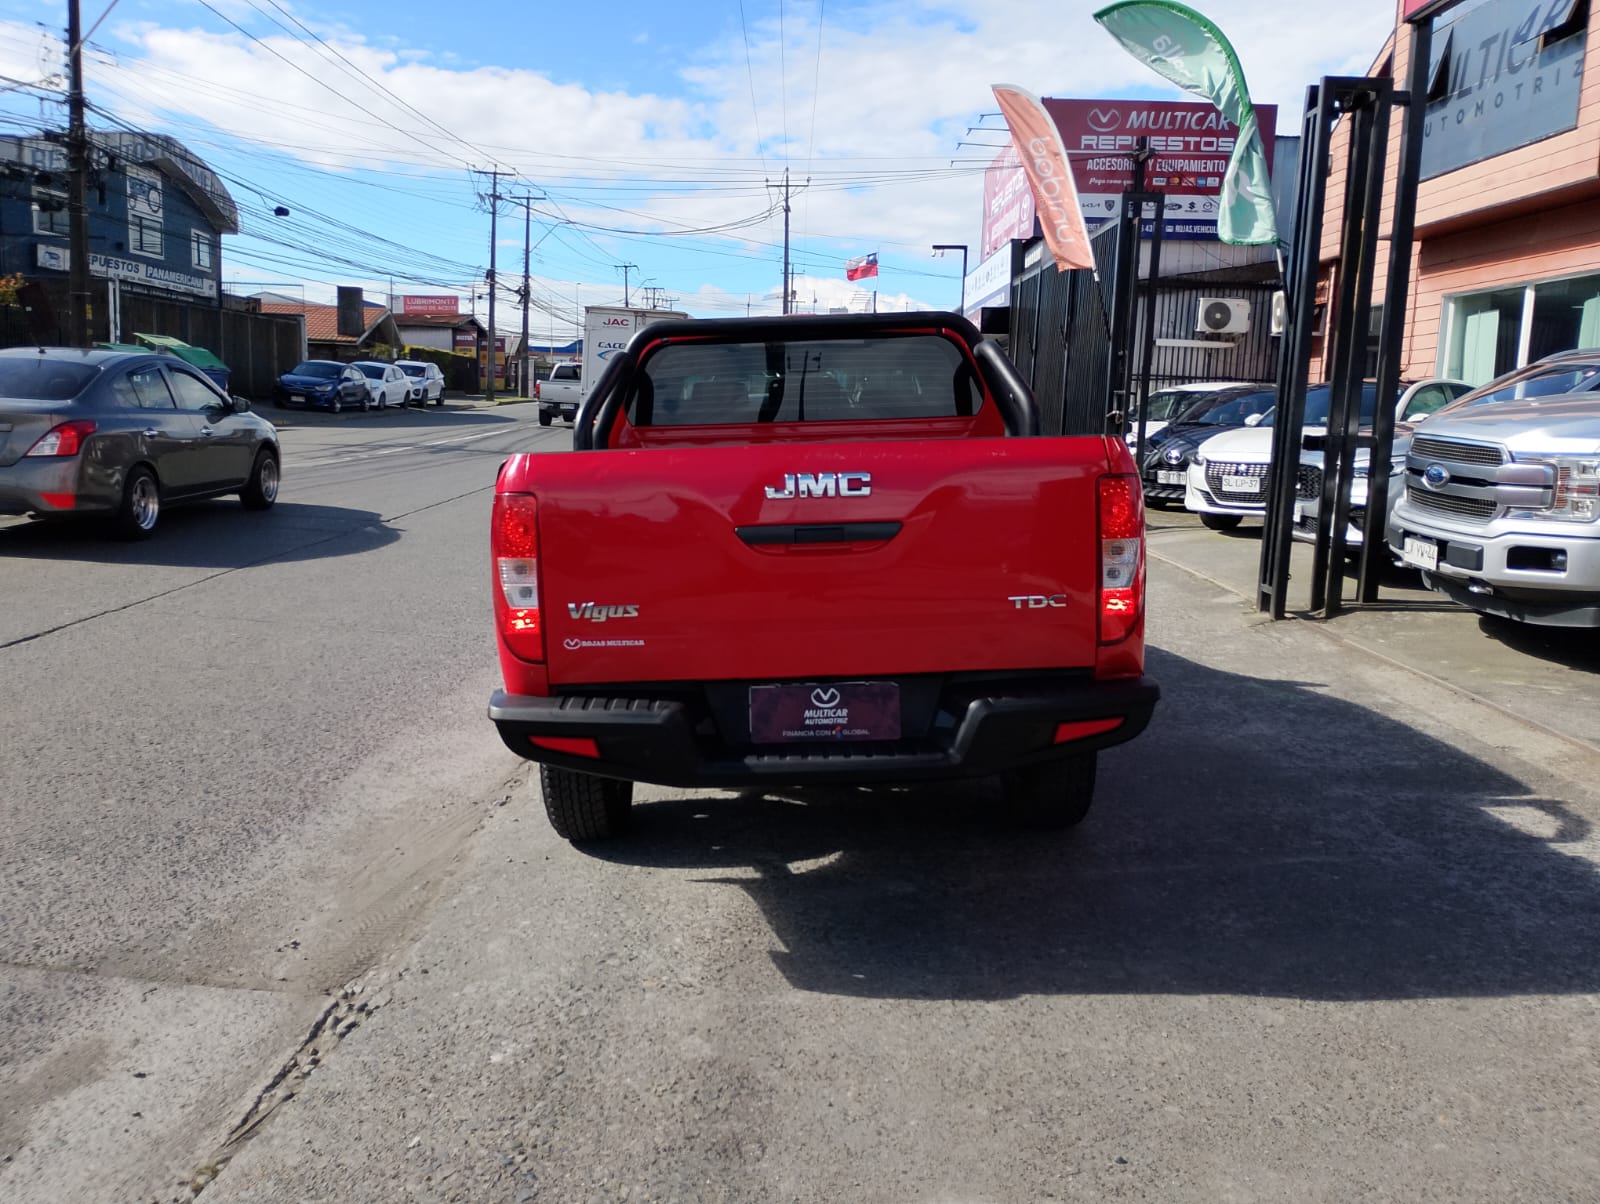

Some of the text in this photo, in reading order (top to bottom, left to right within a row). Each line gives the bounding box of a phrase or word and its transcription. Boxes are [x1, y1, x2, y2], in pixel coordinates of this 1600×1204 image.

[1425, 57, 1585, 138] UTOMOTRIZ
[1126, 110, 1230, 131] MULTICAR
[1081, 135, 1235, 152] REPUESTOS
[1147, 158, 1154, 171] Y
[1155, 158, 1226, 173] EQUIPAMIENTO
[602, 318, 630, 327] JAC
[765, 472, 872, 499] JMC
[1008, 594, 1067, 609] TDC
[567, 602, 640, 623] Vigus
[606, 639, 645, 647] MULTICAR
[803, 708, 848, 718] MULTICAR
[804, 717, 848, 725] AUTOMOTRIZ
[815, 729, 831, 737] CON
